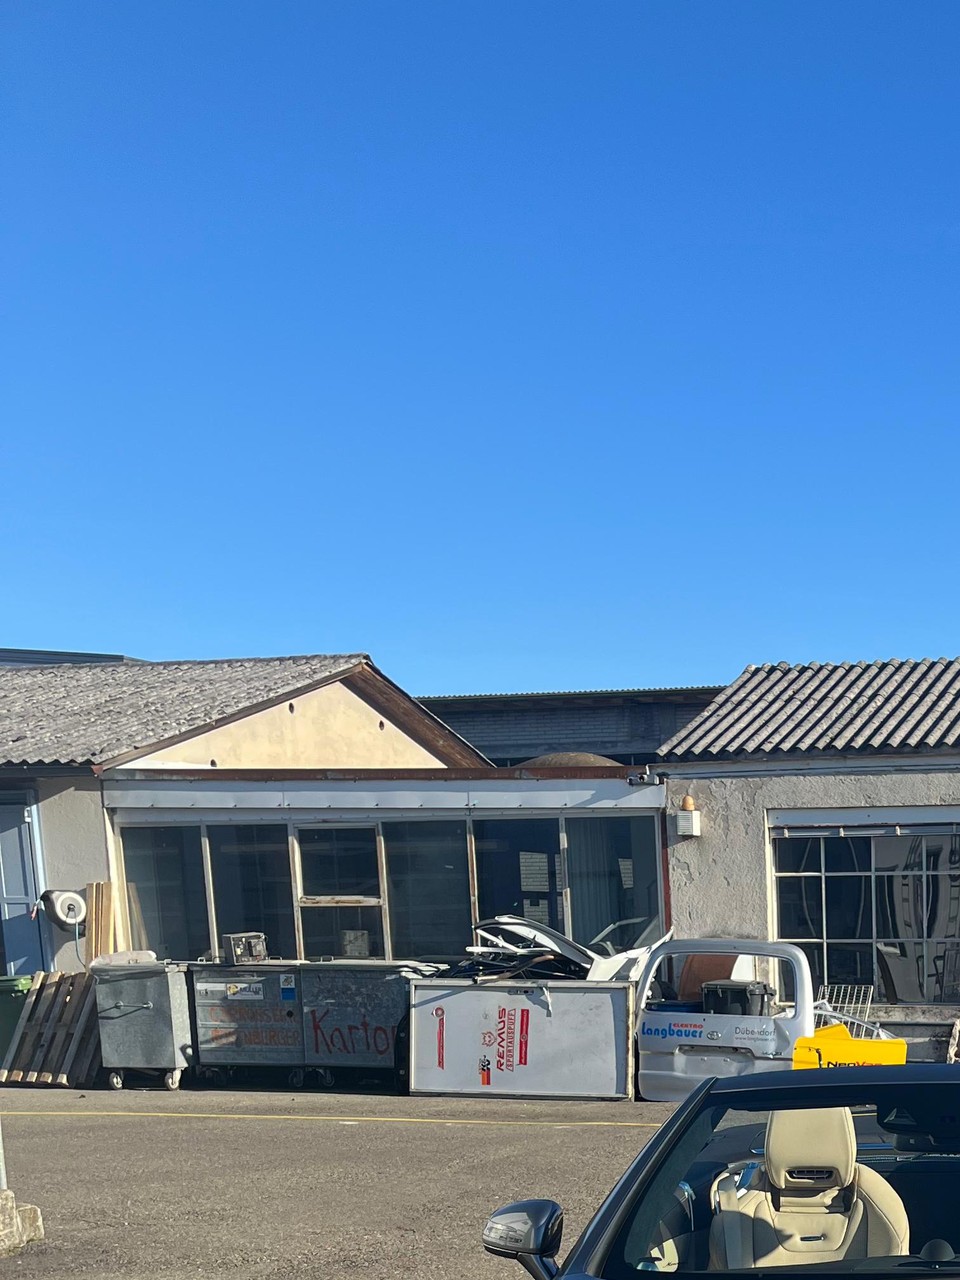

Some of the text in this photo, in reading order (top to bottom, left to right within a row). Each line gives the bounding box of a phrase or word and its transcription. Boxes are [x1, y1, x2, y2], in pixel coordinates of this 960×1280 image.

[641, 1022, 704, 1039] Langbauer
[734, 1026, 776, 1036] Dübendorf
[496, 1007, 506, 1072] REMUS
